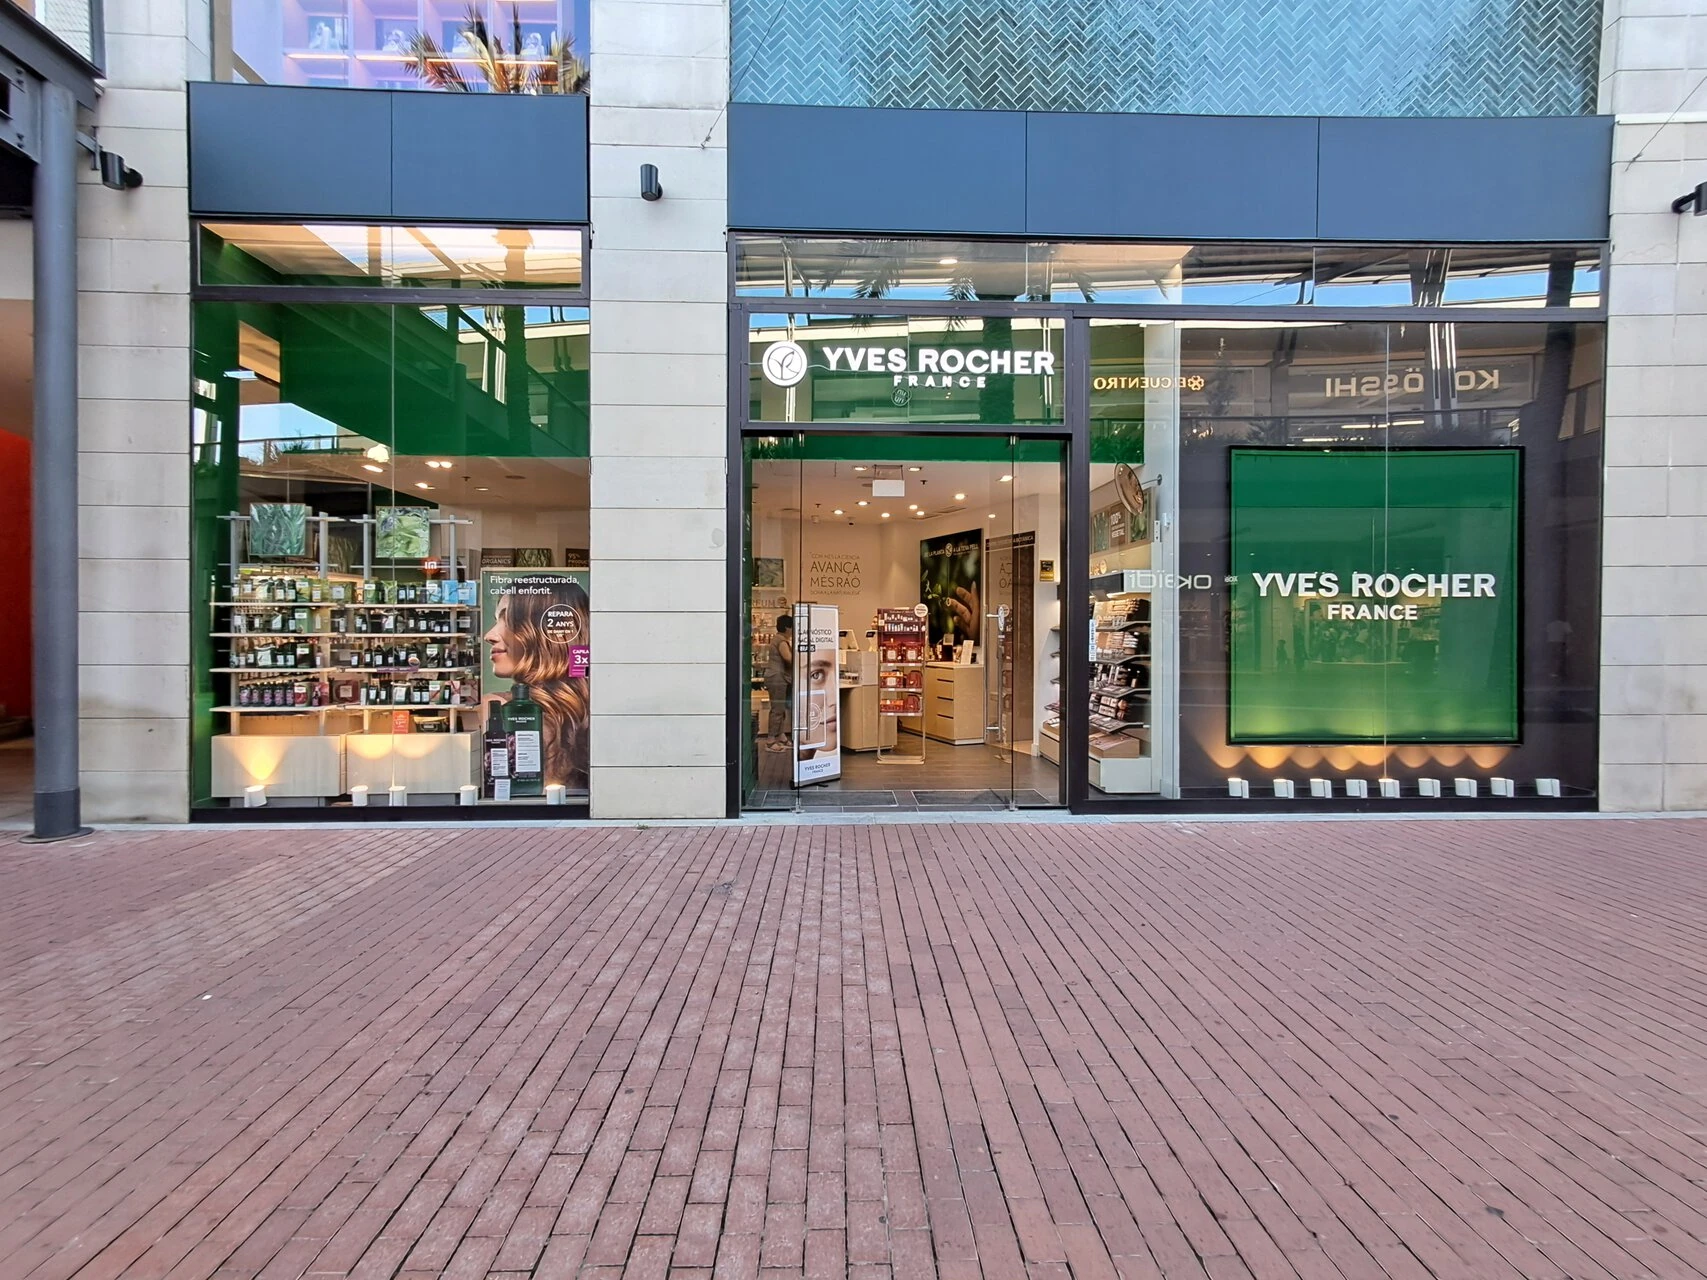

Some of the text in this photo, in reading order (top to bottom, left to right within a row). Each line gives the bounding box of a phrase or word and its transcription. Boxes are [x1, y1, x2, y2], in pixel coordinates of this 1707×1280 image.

[822, 347, 1055, 375] YVES ROCHER
[893, 375, 986, 389] FRANCE
[810, 561, 861, 576] AVANÇA
[490, 575, 580, 585] Fibra reestructurada,
[1252, 572, 1339, 597] YVES
[1351, 573, 1496, 597] ROCHER
[490, 586, 552, 595] cabell enfortit.
[1327, 604, 1417, 620] FRANCE
[547, 618, 554, 627] 2
